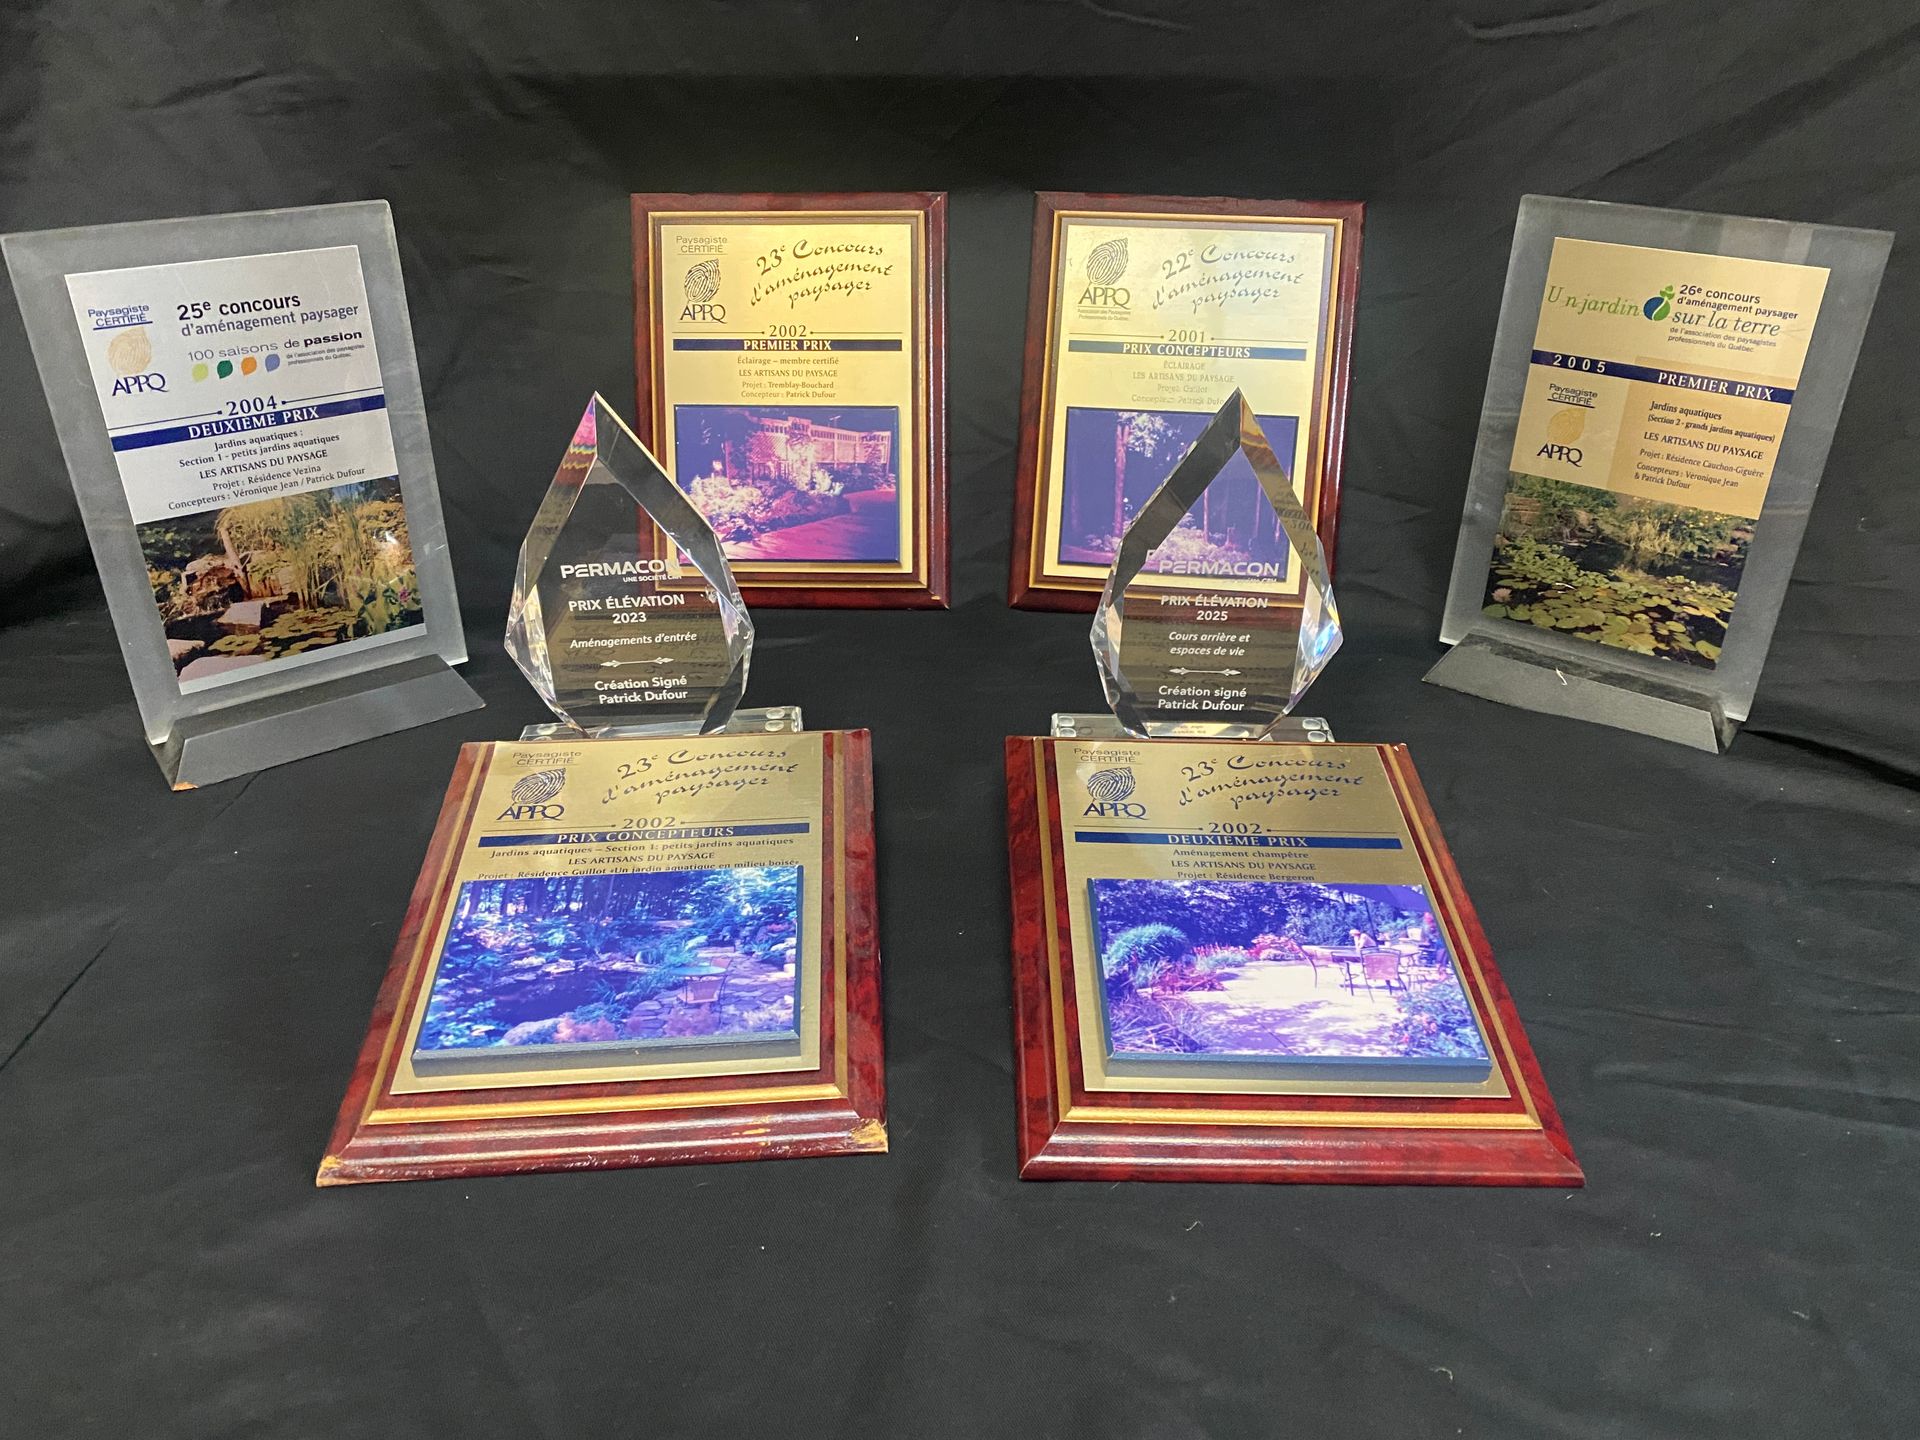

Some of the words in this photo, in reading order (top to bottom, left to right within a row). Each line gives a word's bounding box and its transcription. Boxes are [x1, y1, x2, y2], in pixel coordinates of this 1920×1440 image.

[676, 236, 727, 246] Paysagiste
[793, 240, 883, 259] Concours
[1201, 244, 1296, 264] Concours
[751, 264, 894, 306] d'aménagement
[1153, 270, 1304, 310] d'aménagement
[788, 281, 872, 308] paysager
[1078, 287, 1131, 310] APPQ
[1193, 287, 1280, 314] paysager
[1706, 289, 1760, 304] concours
[88, 304, 149, 318] Paysagiste
[219, 295, 301, 316] concours
[680, 304, 727, 324] APPQ
[1677, 296, 1752, 314] d'aménagement
[1754, 306, 1799, 319] paysager
[181, 311, 295, 336] d'aménagement
[301, 305, 359, 326] paysager
[1672, 311, 1705, 326] sur
[1708, 310, 1728, 329] la
[1732, 314, 1781, 336] terre
[769, 325, 807, 337] 2002
[1168, 330, 1206, 342] 2001
[188, 349, 214, 361] 100
[218, 341, 278, 357] saisons
[284, 338, 300, 349] de
[304, 329, 362, 347] passion
[744, 340, 798, 350] PREMIER
[803, 340, 832, 350] PRIX
[1123, 344, 1151, 354] PRIX
[1157, 345, 1250, 358] CONCEPTEURS
[737, 357, 771, 365] Éclairage
[780, 357, 810, 365] membre
[813, 357, 839, 365] certifié
[1164, 361, 1205, 369] ÉCLAIRAGE
[1553, 354, 1606, 373] 2005
[112, 373, 169, 396] APPQ
[742, 381, 763, 390] Projet
[768, 381, 834, 390] Tremblay-Bouchard
[1148, 373, 1184, 381] ARTISANS
[741, 391, 780, 399] Concepteur
[1549, 383, 1598, 398] Paysagiste
[1658, 372, 1728, 394] PREMIER
[1735, 385, 1774, 401] PRIX
[226, 395, 277, 416] 2004
[1650, 401, 1678, 413] Jardins
[1679, 407, 1722, 420] aquatiques
[188, 413, 276, 439] DEUXIÈME
[283, 407, 319, 423] PRIX
[214, 438, 247, 451] Jardins
[249, 429, 297, 446] aquatiques
[1685, 422, 1708, 431] grands
[1709, 424, 1733, 435] jardins
[1734, 430, 1775, 442] aquatiques)
[179, 455, 215, 468] Section
[231, 447, 257, 462] petits
[259, 441, 296, 456] jardins
[298, 433, 340, 449] aquatiques
[1644, 432, 1659, 441] LES
[1661, 434, 1705, 449] ARTISANS
[1706, 442, 1720, 452] DU
[1722, 446, 1764, 460] PAYSAGE
[1537, 443, 1583, 467] APPQ
[1640, 449, 1660, 459] Projet
[1666, 453, 1702, 466] Résidence
[200, 469, 218, 479] LES
[220, 459, 268, 476] ARTISANS
[270, 457, 285, 467] DU
[287, 449, 327, 464] PAYSAGE
[213, 480, 241, 492] Projet
[248, 470, 291, 484] Résidence
[293, 465, 321, 477] Vezina
[1637, 462, 1679, 477] Concepteurs
[1722, 477, 1738, 487] Jean
[1642, 473, 1664, 484] Patrick
[1667, 478, 1690, 489] Dufour
[168, 493, 226, 510] Concepteurs
[233, 483, 278, 499] Véronique
[280, 478, 299, 492] Jean
[306, 473, 335, 486] Patrick
[337, 466, 365, 480] Dufour
[560, 559, 679, 578] PERMACO
[1159, 561, 1279, 577] PERMACON
[568, 600, 602, 611] PRIX
[606, 594, 685, 609] ÉLÉVATION
[1161, 595, 1190, 606] PRIX
[1195, 594, 1268, 608] ÉLÉVATION
[612, 612, 647, 624] 2023
[1196, 611, 1228, 621] 2025
[570, 636, 652, 648] Aménagements
[655, 632, 697, 643] d'entrée
[1169, 632, 1198, 641] Cours
[1200, 632, 1236, 642] arrière
[1239, 634, 1250, 642] et
[1170, 647, 1210, 656] espaces
[1214, 646, 1225, 655] de
[1229, 647, 1245, 656] vie
[595, 678, 649, 691] Création
[652, 675, 687, 689] Signé
[599, 692, 642, 704] Patrick
[645, 690, 688, 701] Dufour
[1159, 686, 1210, 696] Création
[1214, 688, 1247, 699] signé
[1158, 700, 1199, 709] Patrick
[1202, 700, 1244, 711] Dufour
[668, 750, 788, 764] Concours
[1227, 755, 1346, 769] Concours
[602, 763, 798, 805] d'aménagement
[656, 777, 769, 804] paysager
[1179, 771, 1364, 806] d'aménagement
[1232, 787, 1341, 810] paysager
[496, 804, 565, 821] APPQ
[1083, 802, 1147, 820] APPQ
[623, 817, 676, 829] 2002
[1209, 823, 1263, 834] 2002
[557, 832, 600, 844] PRIX
[606, 827, 734, 841] CONCEPTEURS
[1168, 833, 1260, 846] DEUXIÈME
[1267, 836, 1308, 847] PRIX
[490, 850, 529, 859] Jardins
[532, 847, 592, 856] aquatiques
[662, 842, 693, 851] petits
[695, 840, 733, 849] jardins
[736, 838, 794, 847] aquatiques
[1173, 849, 1248, 857] Aménagement
[1252, 851, 1309, 859] champêtre
[590, 856, 643, 864] ARTISANS
[647, 854, 664, 862] DU
[667, 852, 715, 860] PAYSAGE
[518, 870, 568, 878] Résidence
